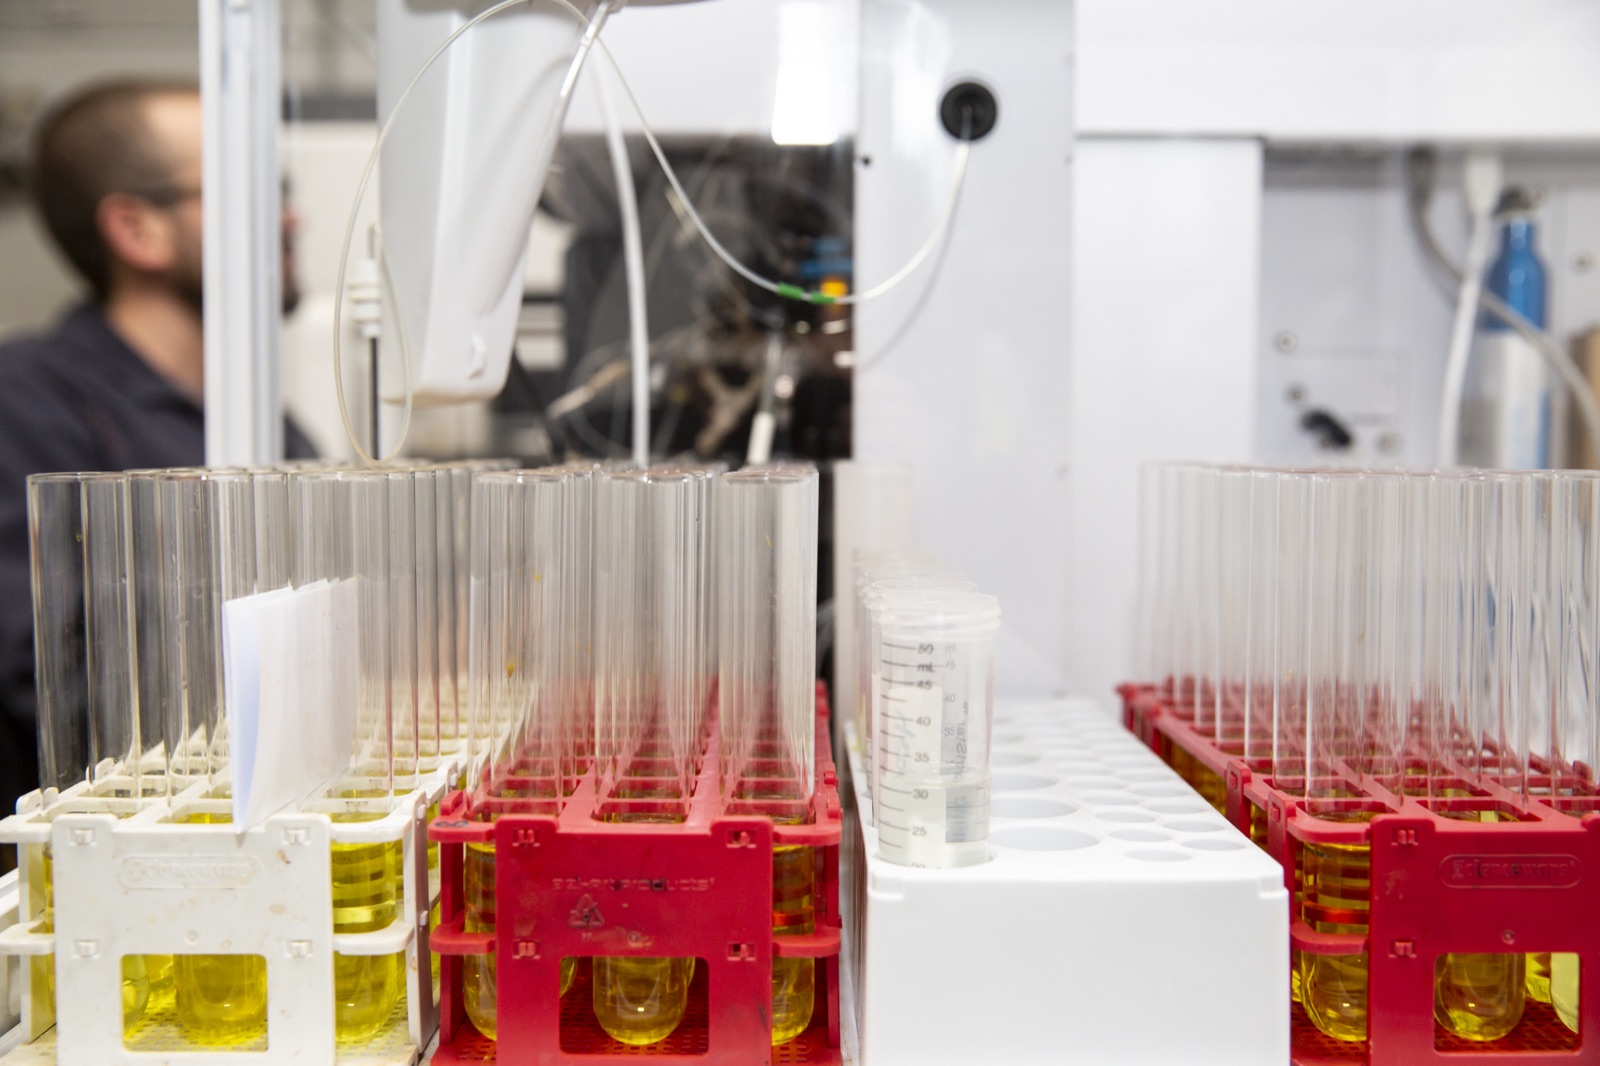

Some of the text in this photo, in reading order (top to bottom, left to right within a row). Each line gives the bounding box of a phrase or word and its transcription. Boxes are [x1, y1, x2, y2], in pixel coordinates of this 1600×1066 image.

[917, 643, 934, 654] 50
[917, 680, 932, 690] 45
[915, 716, 931, 726] 40
[914, 753, 930, 763] 35
[913, 788, 929, 800] 30
[912, 826, 927, 837] 25
